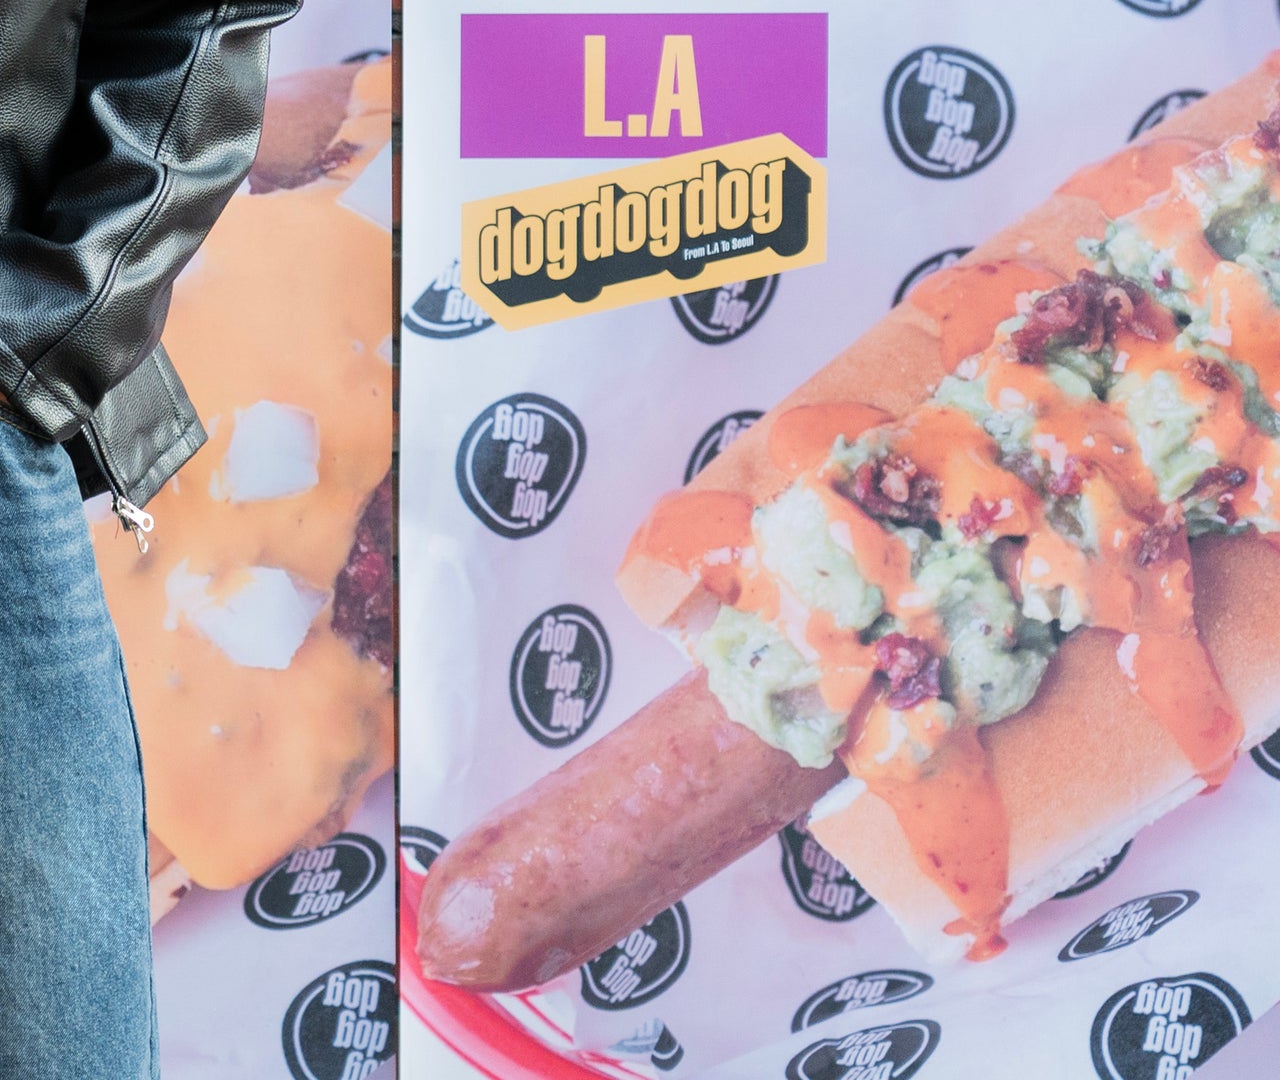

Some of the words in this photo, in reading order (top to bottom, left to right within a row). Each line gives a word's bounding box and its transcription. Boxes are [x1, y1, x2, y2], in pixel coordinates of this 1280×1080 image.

[585, 36, 703, 137] L.A
[478, 157, 788, 287] dogdogdog
[684, 247, 706, 261] From
[707, 242, 720, 256] L.A
[721, 240, 730, 253] To
[731, 234, 755, 251] Seoul
